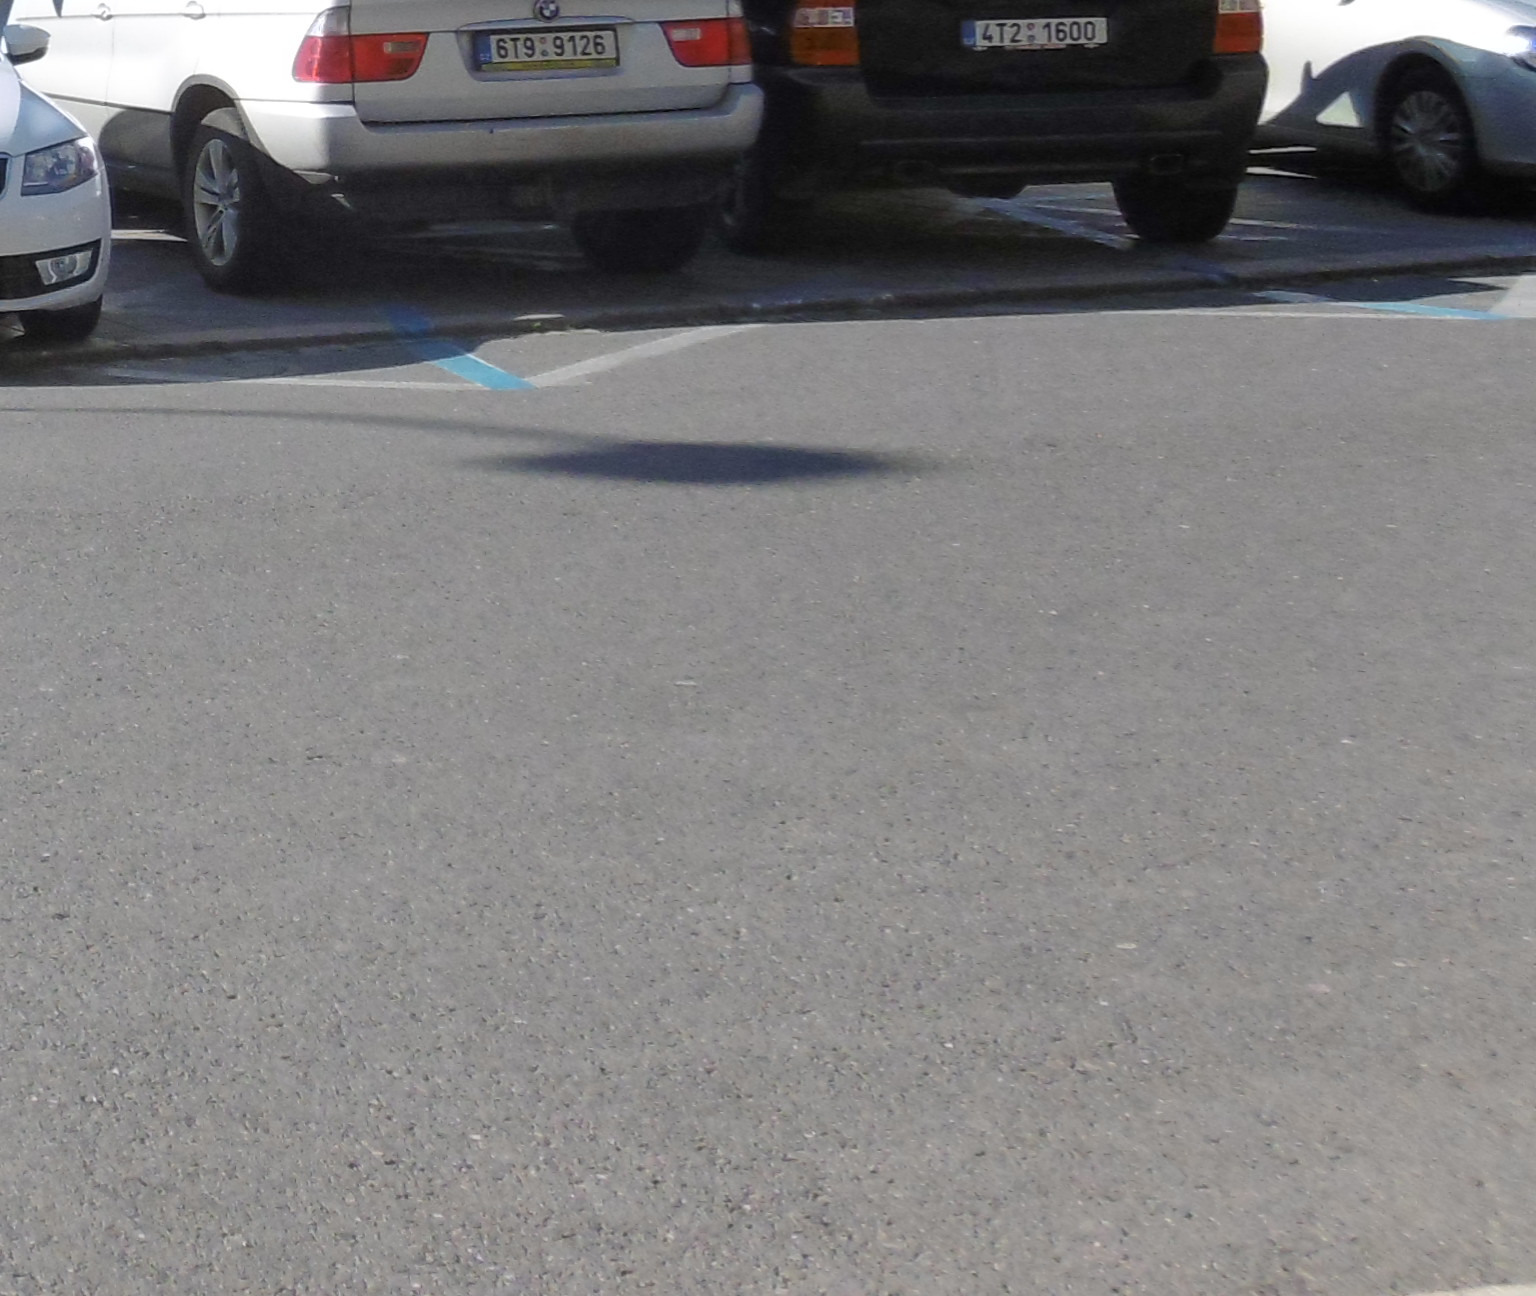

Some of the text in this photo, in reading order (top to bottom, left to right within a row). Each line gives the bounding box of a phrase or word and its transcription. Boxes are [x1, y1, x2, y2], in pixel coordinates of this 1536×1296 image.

[982, 20, 1096, 44] 4T2 1600
[495, 34, 606, 59] 6T9 9126
